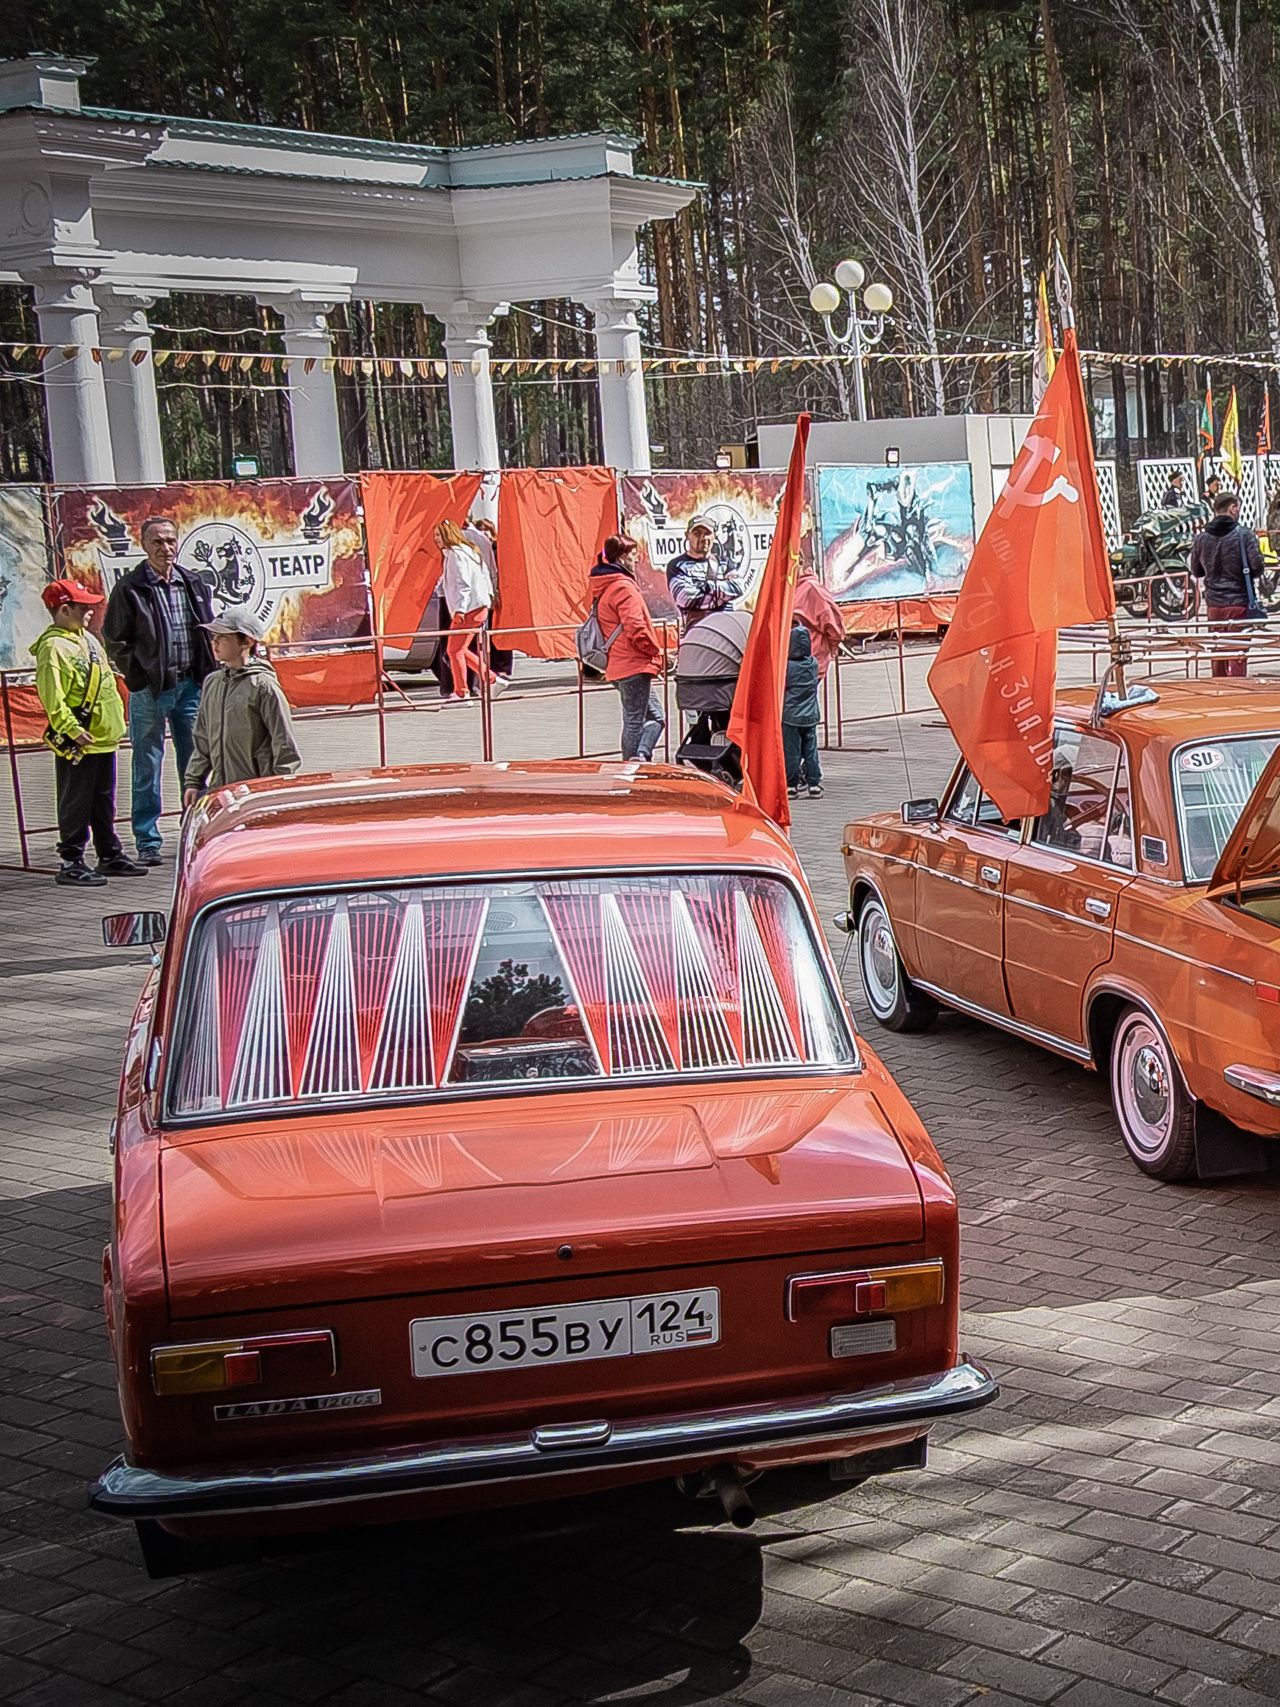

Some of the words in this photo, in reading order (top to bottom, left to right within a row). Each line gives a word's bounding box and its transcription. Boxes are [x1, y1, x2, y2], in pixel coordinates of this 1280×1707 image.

[268, 554, 325, 578] ТЕАТР
[1000, 675, 1029, 698] 3
[1191, 752, 1213, 767] SU
[431, 1315, 624, 1368] С855ВУ
[636, 1296, 705, 1335] 124
[650, 1331, 686, 1346] RUS
[227, 1400, 307, 1418] LADA
